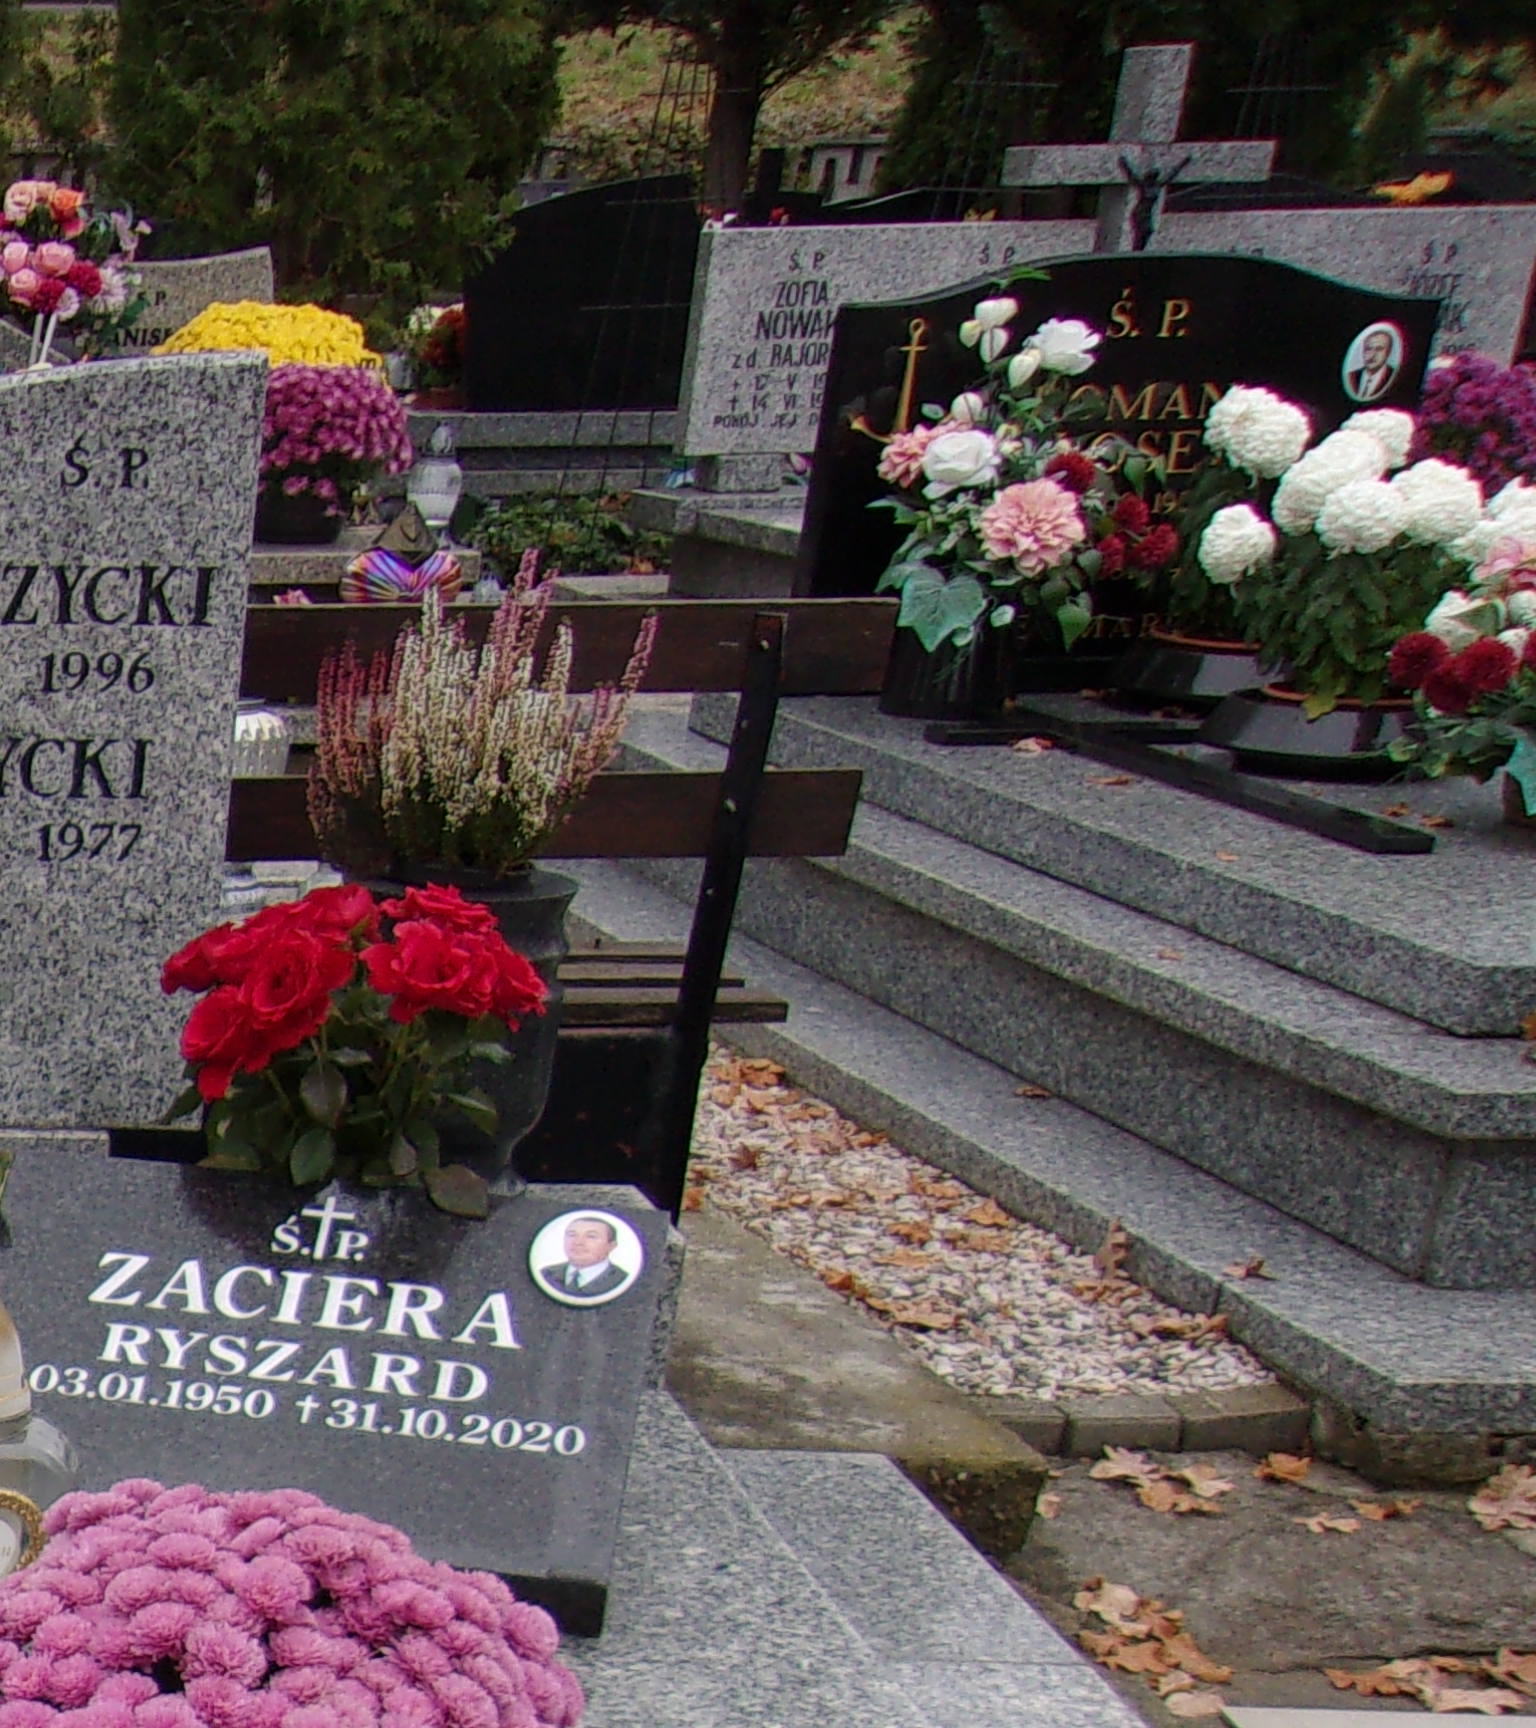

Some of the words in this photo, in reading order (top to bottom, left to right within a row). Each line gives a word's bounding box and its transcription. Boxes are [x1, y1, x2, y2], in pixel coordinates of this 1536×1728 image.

[776, 281, 828, 309] ZOFIA
[87, 1250, 525, 1351] ZACIERA
[96, 1321, 492, 1405] RYSZARD
[27, 1363, 276, 1420] 03.01.1950
[324, 1396, 587, 1457] 31.10.2020
